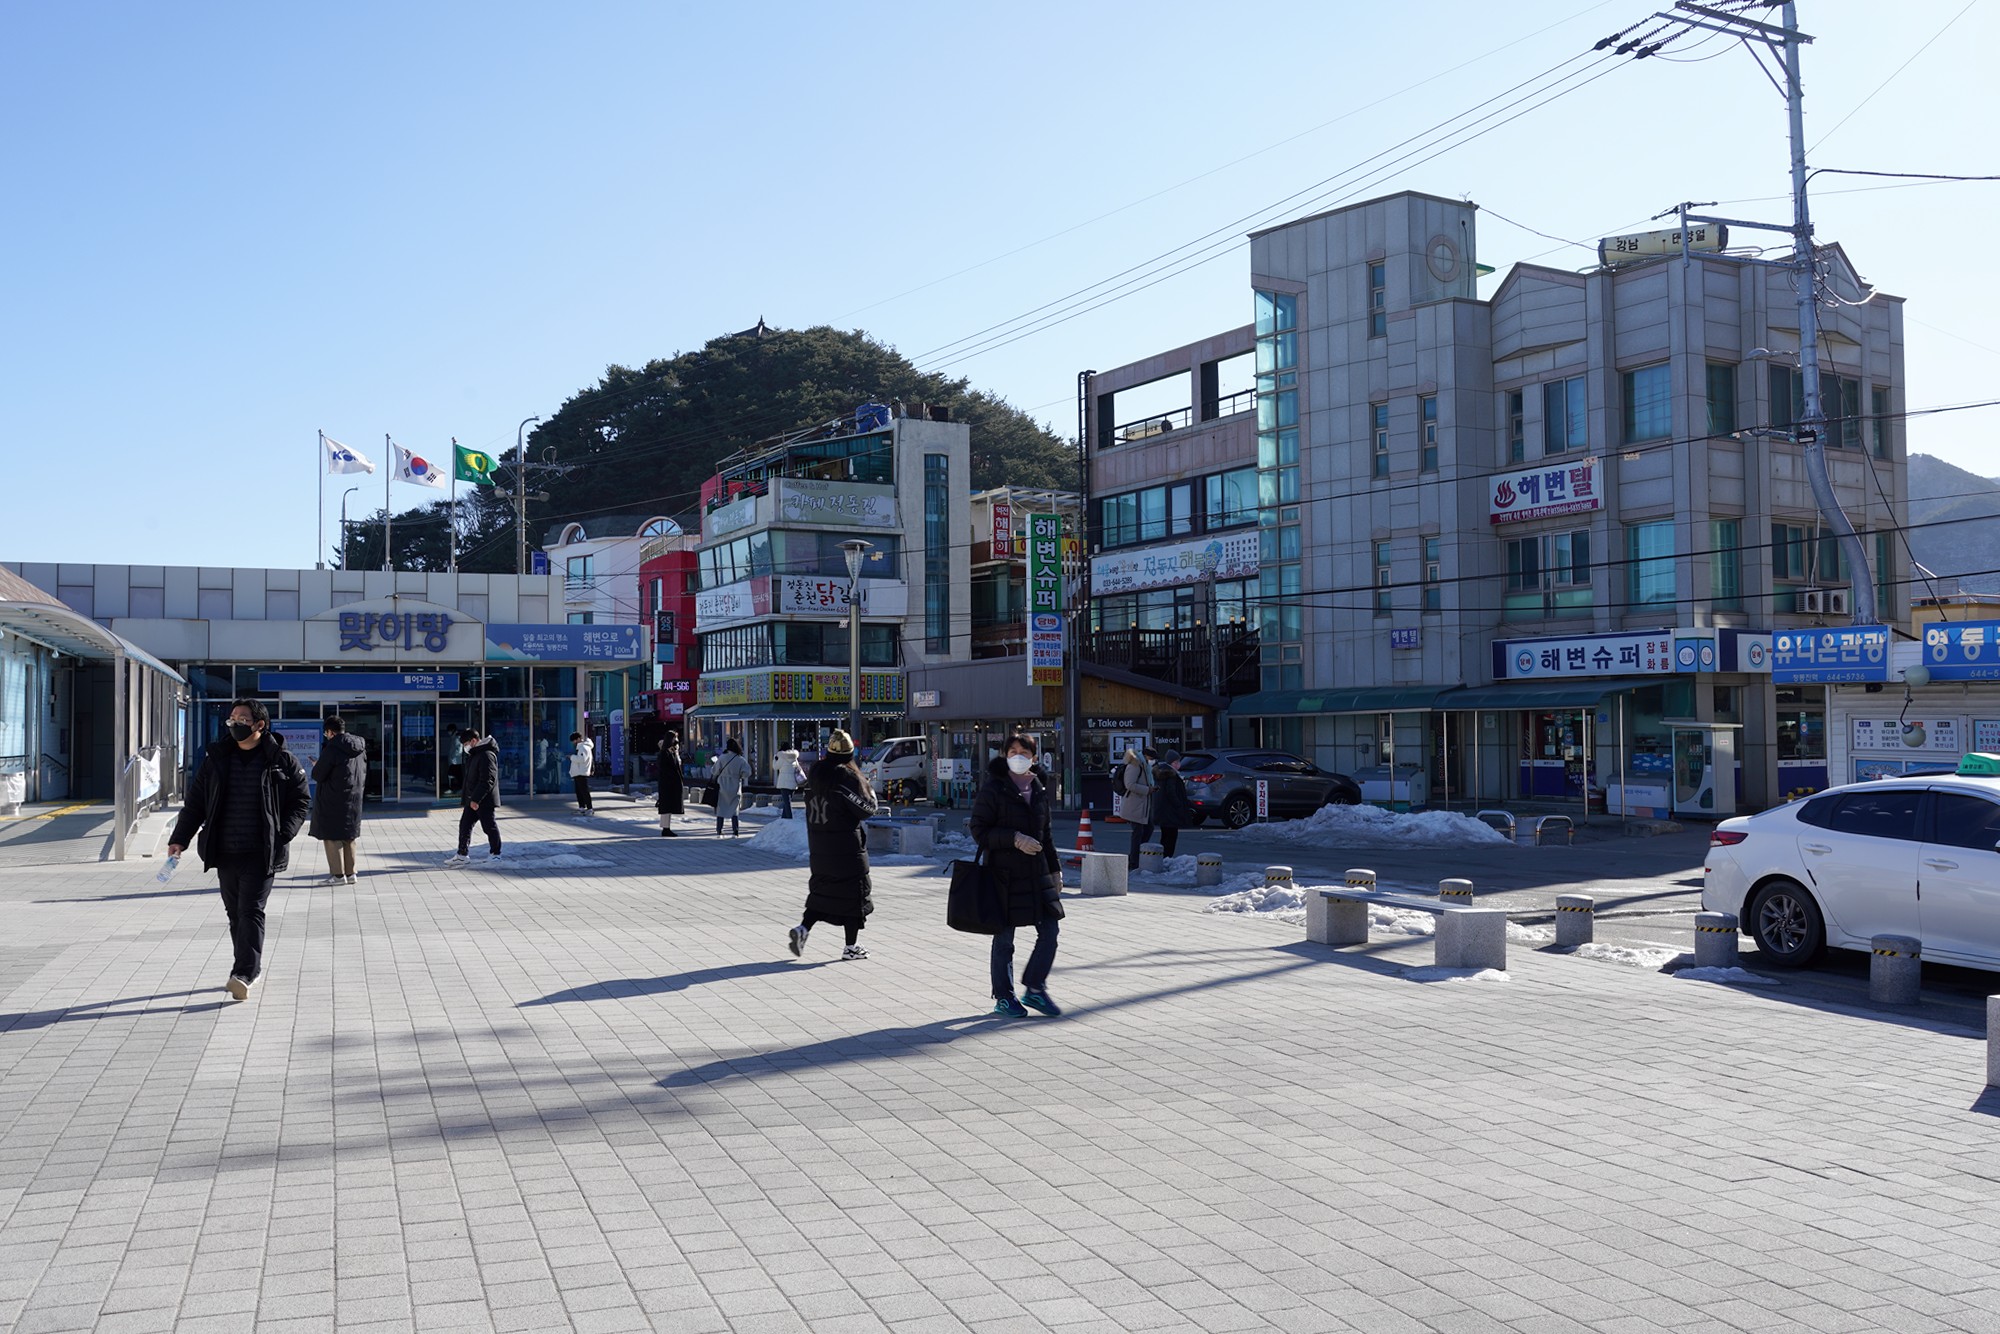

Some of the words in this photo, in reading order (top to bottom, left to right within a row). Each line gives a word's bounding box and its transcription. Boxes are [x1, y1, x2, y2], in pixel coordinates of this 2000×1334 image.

[1616, 237, 1639, 251] 강남
[1517, 465, 1593, 504] 해변텔
[791, 494, 824, 512] 카페
[1034, 518, 1058, 611] 해변슈퍼
[1143, 555, 1178, 577] 정동진
[1179, 549, 1218, 572] 해물탕
[787, 579, 814, 591] 정동진
[1037, 617, 1057, 626] 담배
[339, 612, 454, 653] 맞이방
[522, 633, 535, 642] 일출
[536, 633, 555, 642] 최고의
[556, 633, 568, 642] 명소
[583, 632, 619, 642] 해변으로
[1392, 630, 1416, 643] 해변텔
[1774, 632, 1887, 664] 유니온관광
[1926, 626, 2000, 663] 영동
[583, 645, 602, 656] 가는
[603, 645, 613, 657] 길
[614, 646, 631, 654] 100m
[1540, 643, 1641, 672] 해변슈퍼
[404, 675, 433, 684] 들어가는
[436, 675, 444, 684] 곳
[1827, 672, 1865, 681] 644-5736
[1970, 670, 2000, 678] 644-5
[1035, 719, 1046, 727] Take
[1097, 719, 1117, 727] Take
[1118, 719, 1133, 728] out
[1154, 736, 1169, 744] Take
[848, 793, 863, 805] NEW
